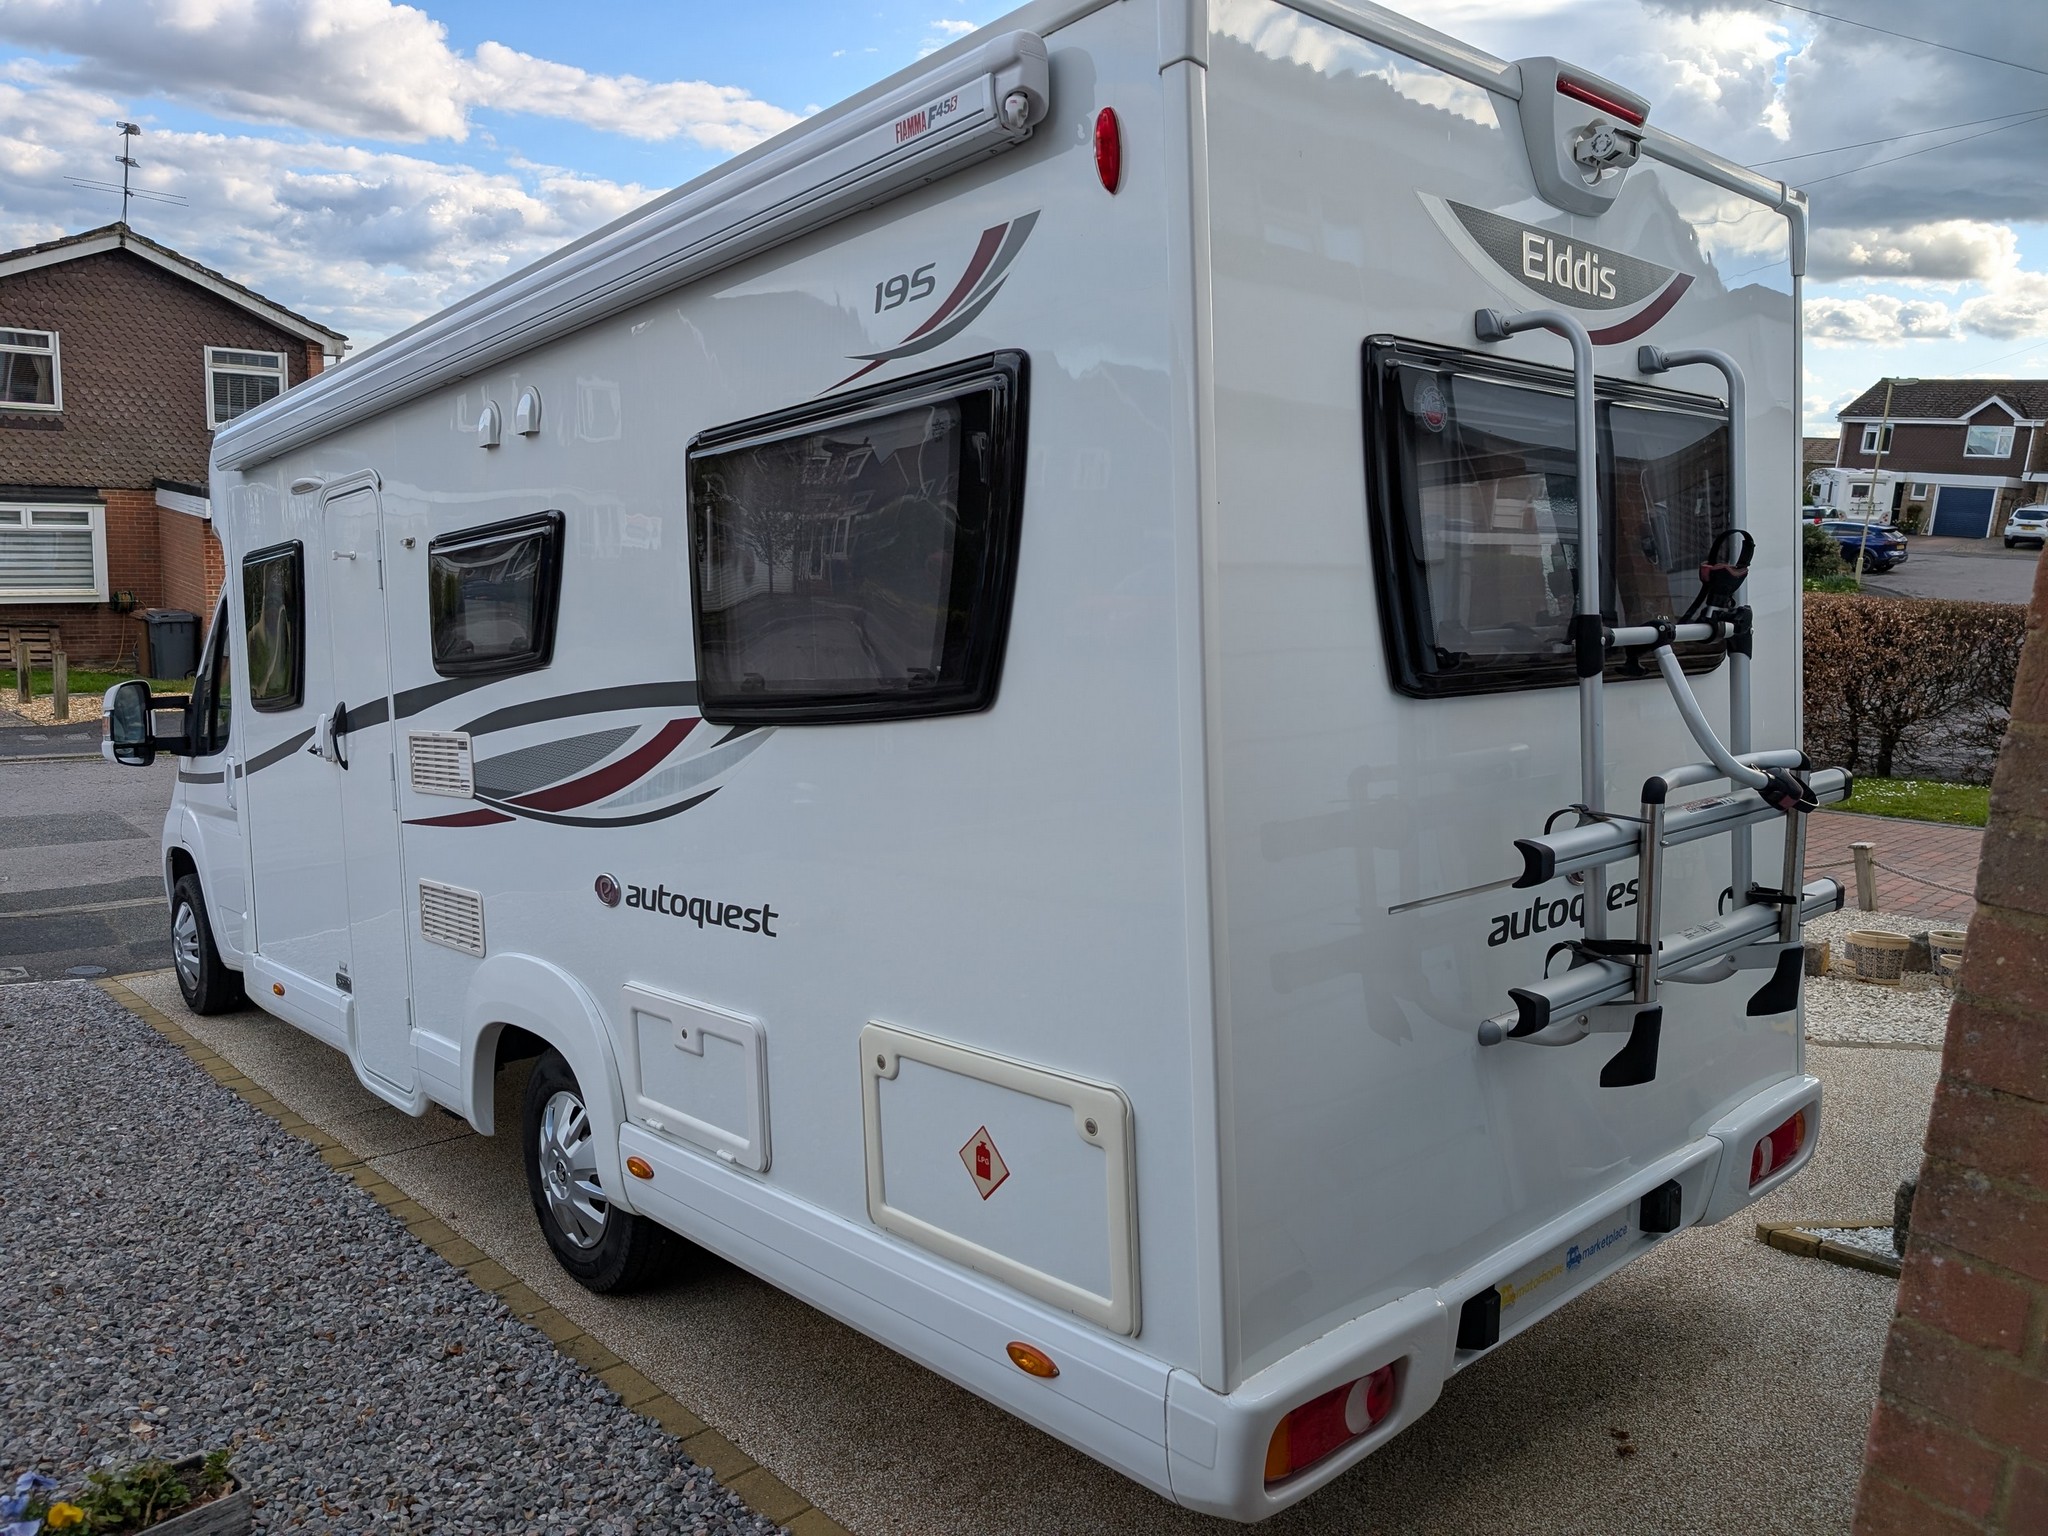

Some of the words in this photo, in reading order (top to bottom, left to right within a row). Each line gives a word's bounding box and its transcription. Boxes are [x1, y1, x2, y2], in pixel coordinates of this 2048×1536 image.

[895, 111, 927, 144] FIAMMA
[1522, 230, 1616, 300] Elddis
[875, 262, 936, 314] 195
[626, 884, 779, 938] autoquest
[977, 1154, 990, 1166] LPG
[1582, 1224, 1628, 1260] marketplace
